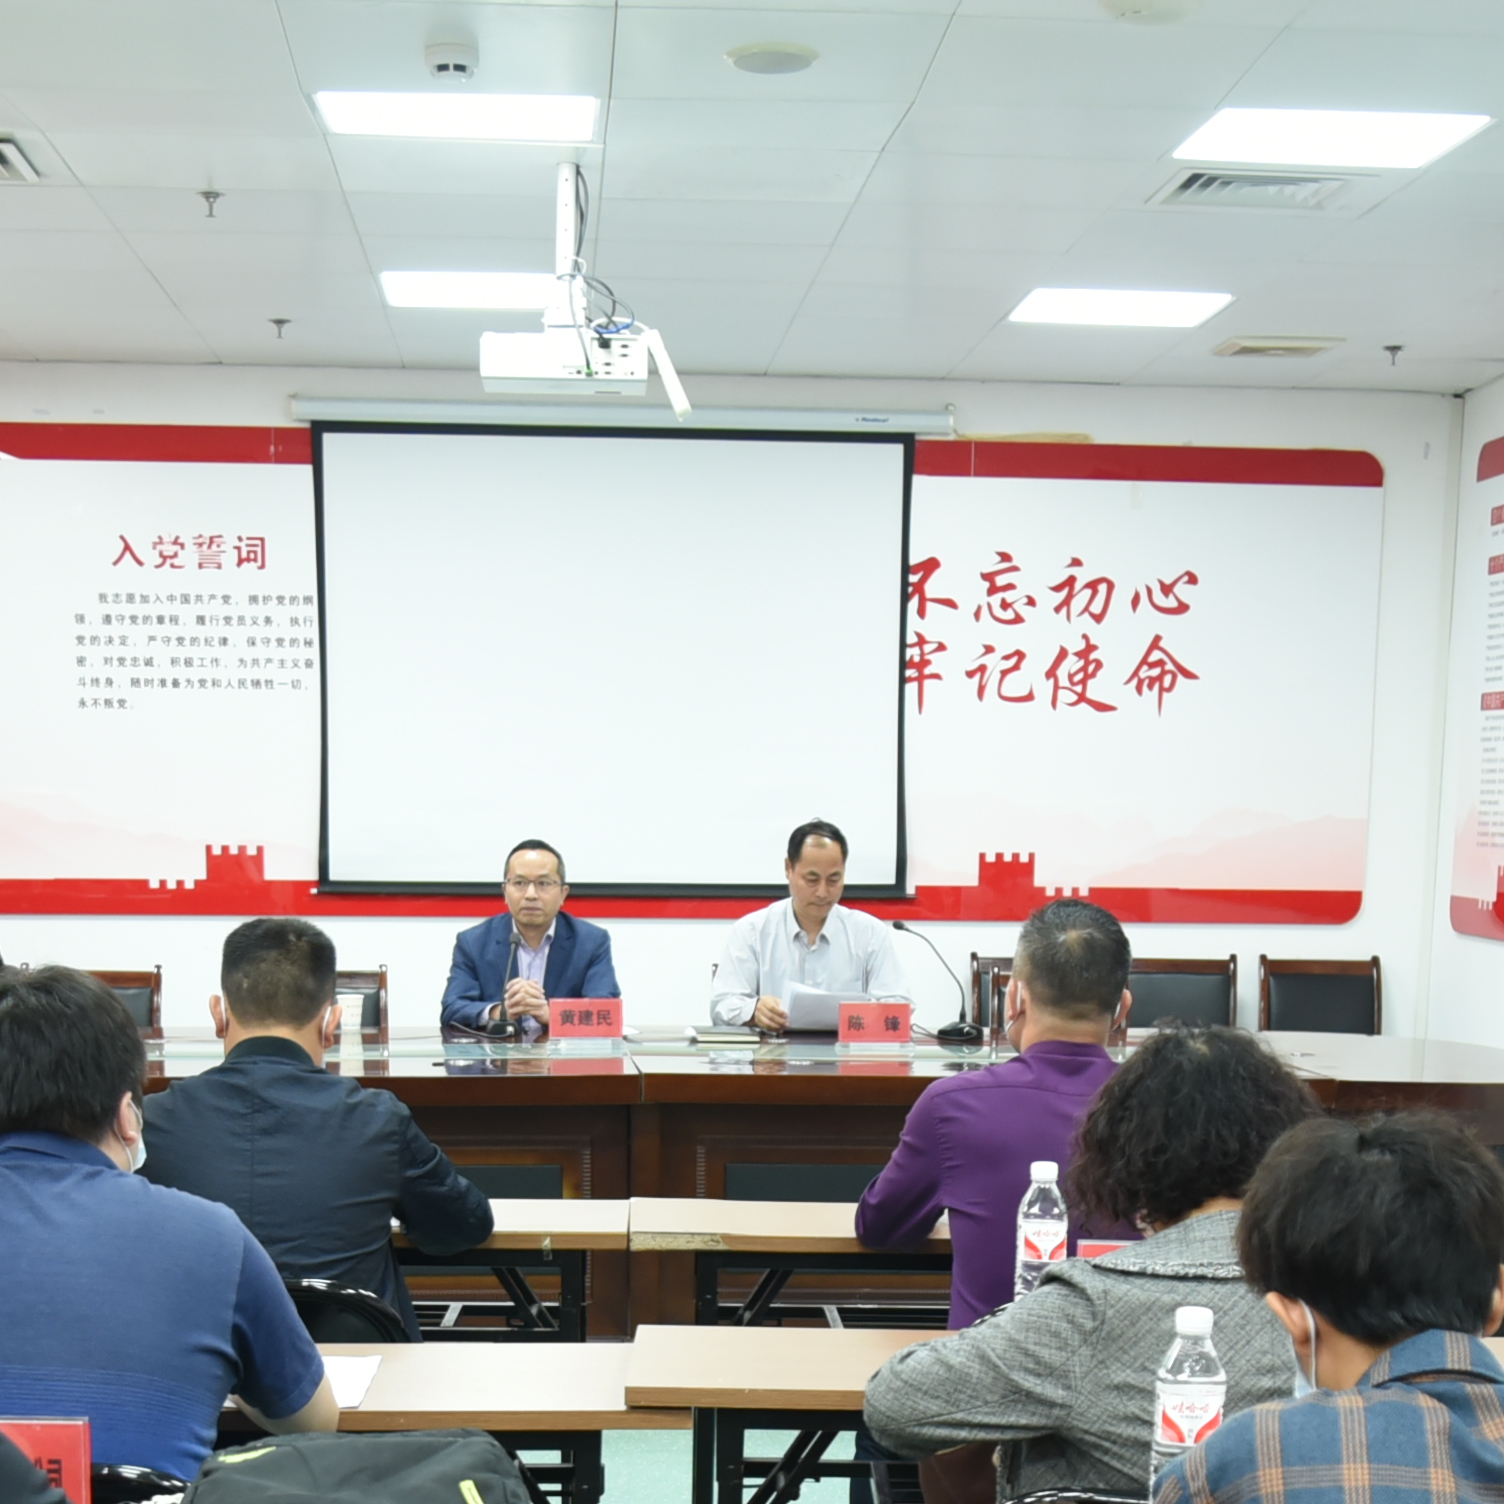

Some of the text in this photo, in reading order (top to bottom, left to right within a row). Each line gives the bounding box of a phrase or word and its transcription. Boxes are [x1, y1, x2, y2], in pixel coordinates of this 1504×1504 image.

[111, 533, 267, 570] 入党誓词
[908, 551, 1199, 626] 不忘初心
[905, 630, 1200, 718] 牢记使命
[559, 1009, 613, 1027] 黄建民
